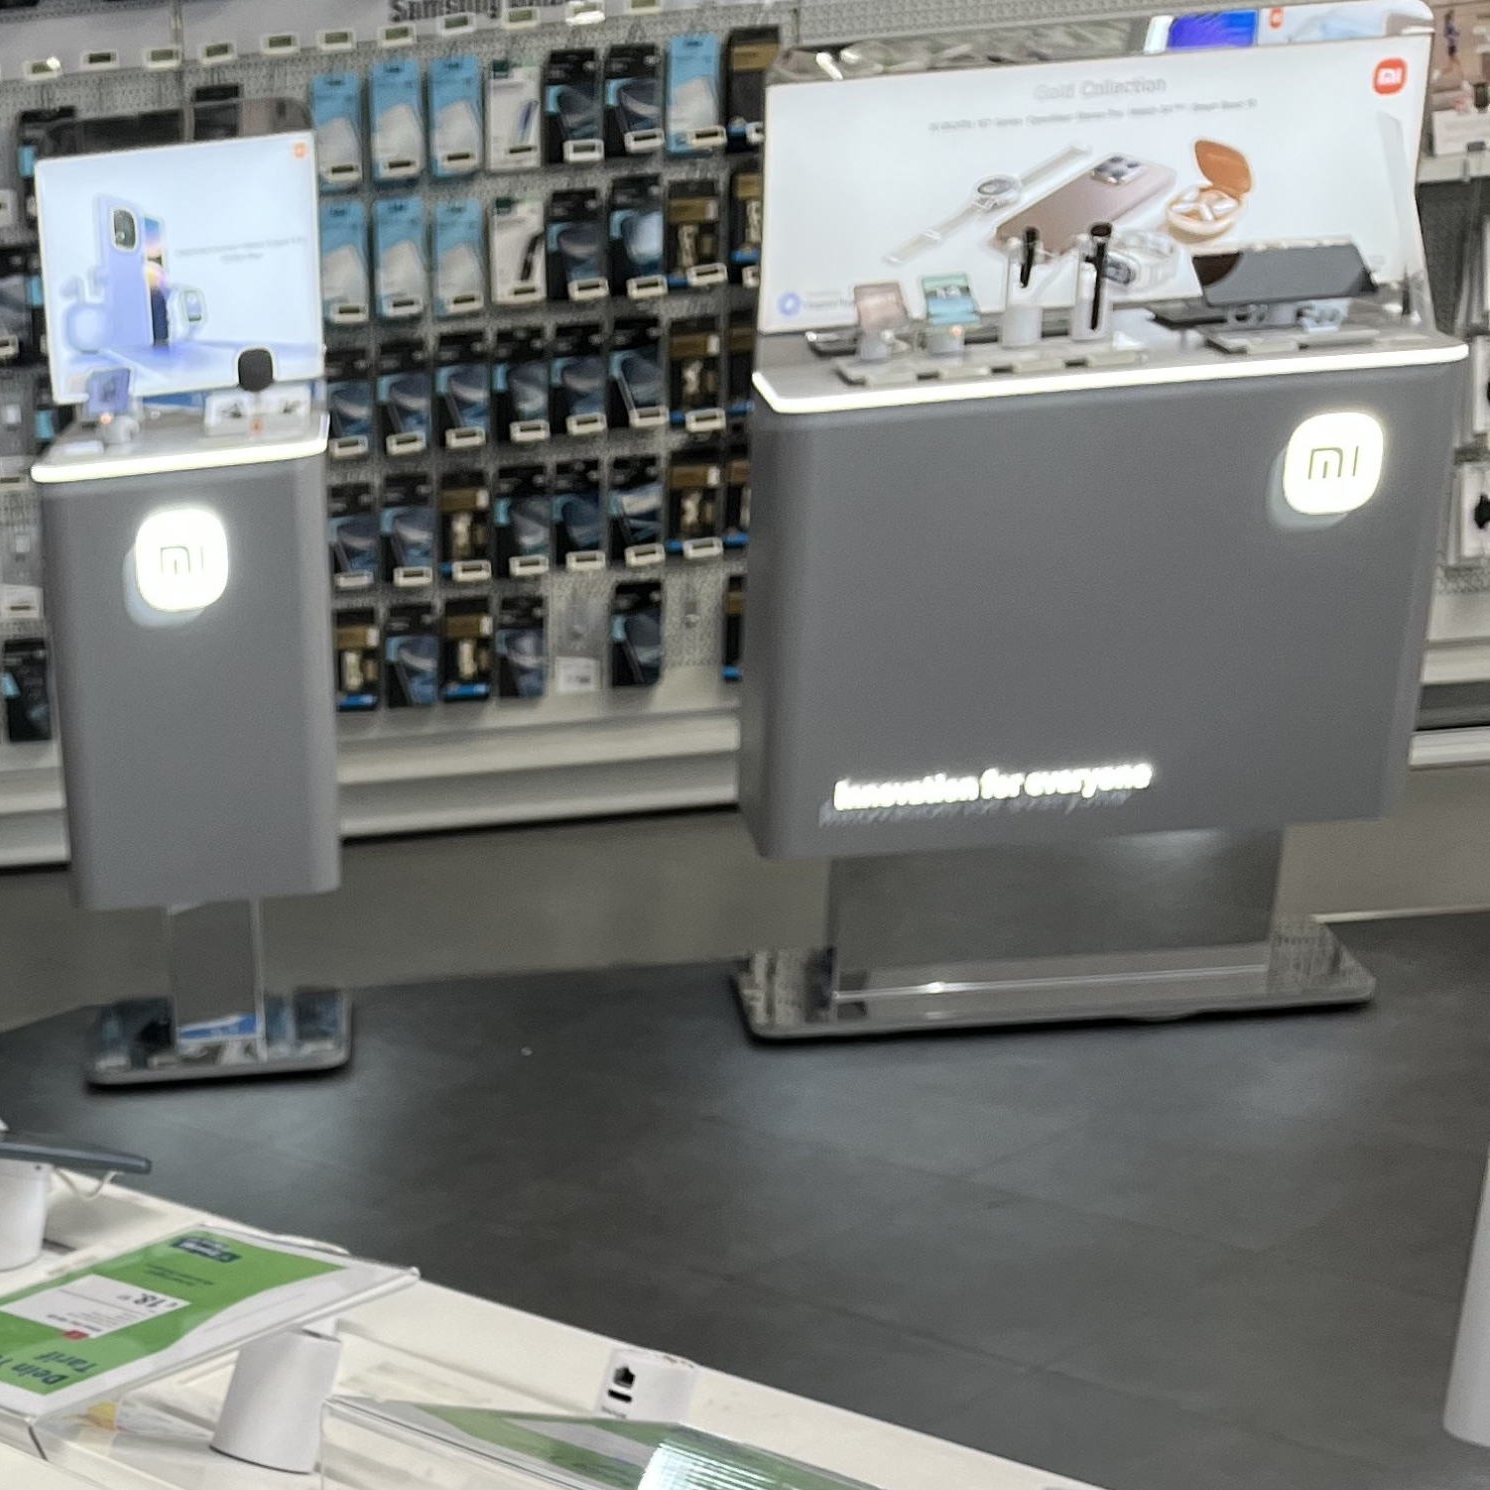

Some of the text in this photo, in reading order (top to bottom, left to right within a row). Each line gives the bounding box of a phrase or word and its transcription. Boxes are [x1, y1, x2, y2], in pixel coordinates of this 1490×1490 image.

[1080, 77, 1166, 97] Collection
[33, 1351, 98, 1373] Tarif
[12, 1363, 69, 1385] Dein
